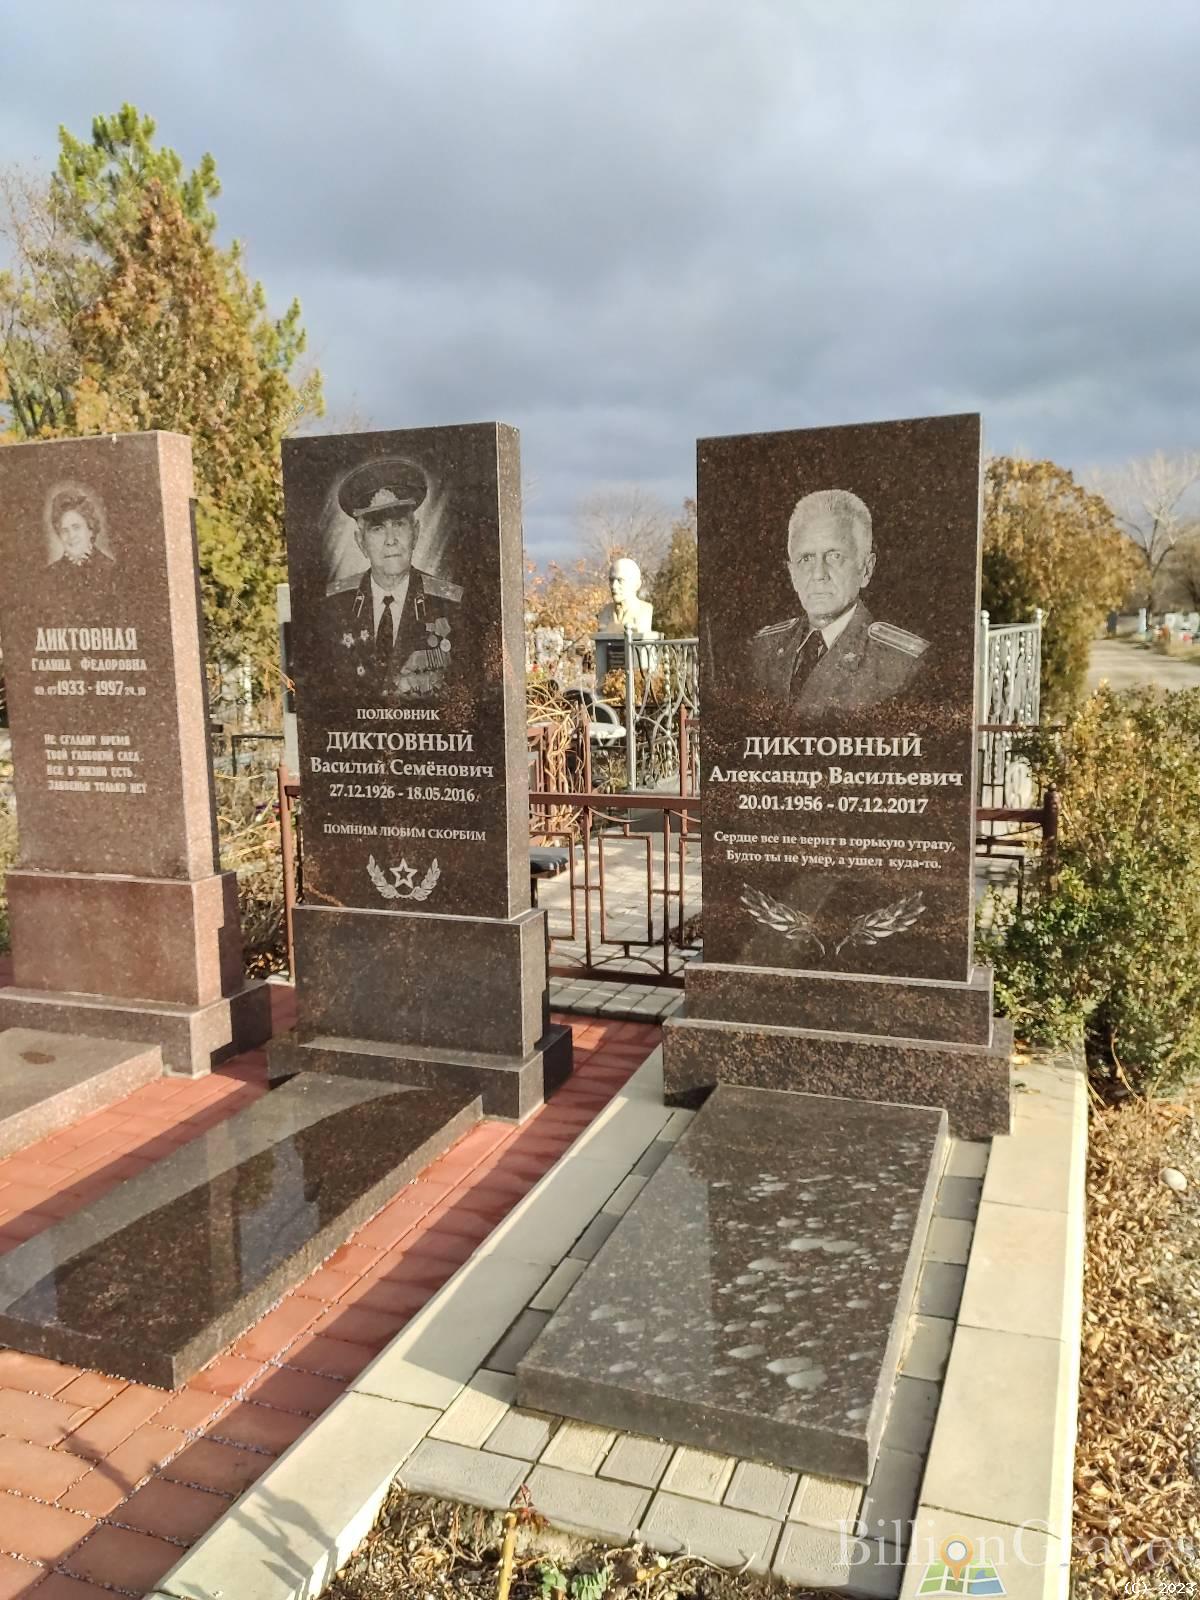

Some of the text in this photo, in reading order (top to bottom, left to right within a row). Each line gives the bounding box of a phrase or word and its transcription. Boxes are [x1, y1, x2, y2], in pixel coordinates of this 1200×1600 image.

[35, 627, 138, 652] ДИКТОВНАЯ
[31, 657, 147, 672] ГАЛИНА ФЕДОРОВНА
[356, 708, 441, 721] ПОЛКОВНИК
[326, 730, 474, 753] ДИКТОВНЫЙ
[743, 732, 923, 759] ДИКТОВНЫЙ
[310, 757, 494, 778] Василий Семёнович
[708, 766, 964, 788] Александр Васильевич
[329, 784, 396, 799] 27.12.1926
[407, 787, 476, 802] 18.05.2016
[738, 794, 823, 811] 20.01.1956
[838, 797, 929, 814] 07.12.2017
[323, 823, 486, 841] ПОМНИМ ЛЮБИМ СКОРБИМ
[714, 831, 956, 853] Сердце все не верит в горькую утрату,
[726, 849, 942, 870] Будто ты не умер, а ушел куда-то.
